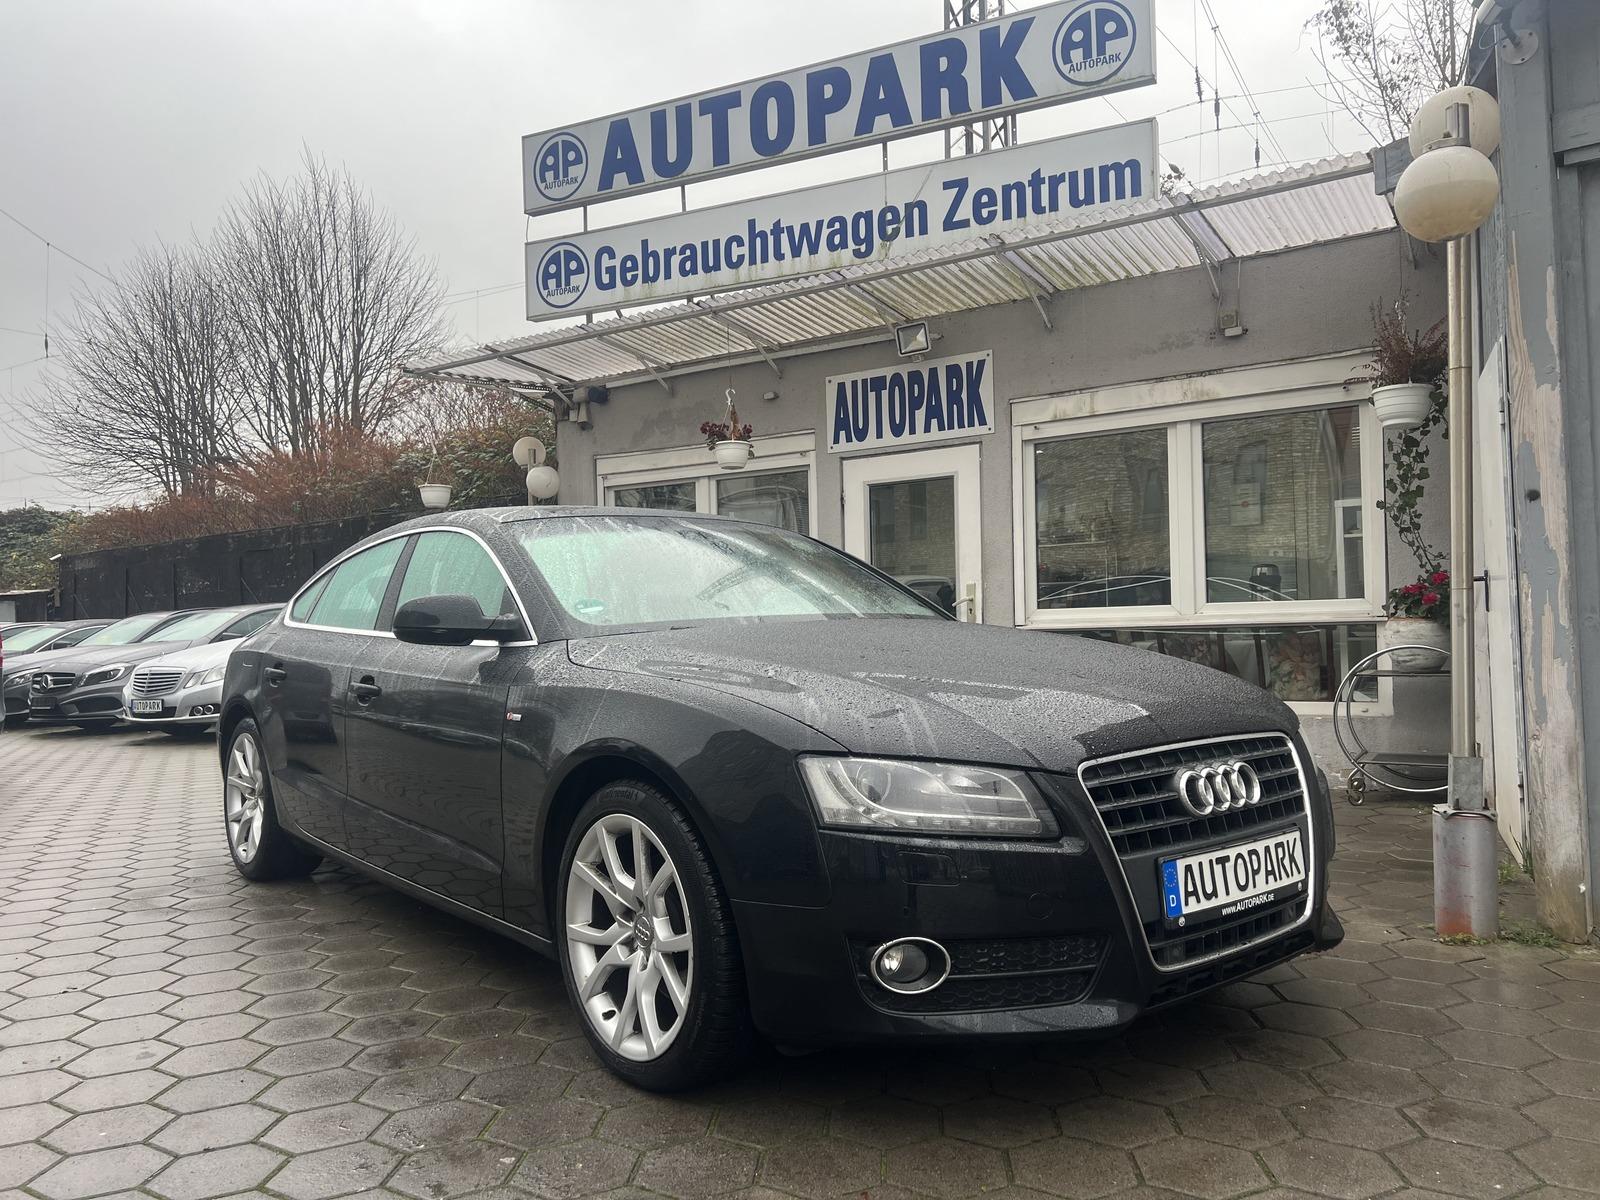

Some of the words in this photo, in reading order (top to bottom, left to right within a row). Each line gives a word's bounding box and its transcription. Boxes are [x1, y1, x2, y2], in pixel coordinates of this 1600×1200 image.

[1069, 52, 1122, 74] AUTOPARK
[597, 16, 1038, 192] AUTOPARK
[544, 176, 579, 190] AUTOPARK
[594, 199, 929, 291] Gebrauchtwagen
[942, 158, 1142, 232] Zentrum
[546, 285, 580, 298] AUTOPARK
[832, 359, 988, 445] AUTOPARK
[1169, 895, 1177, 906] D
[1183, 837, 1301, 906] AUTOPARK
